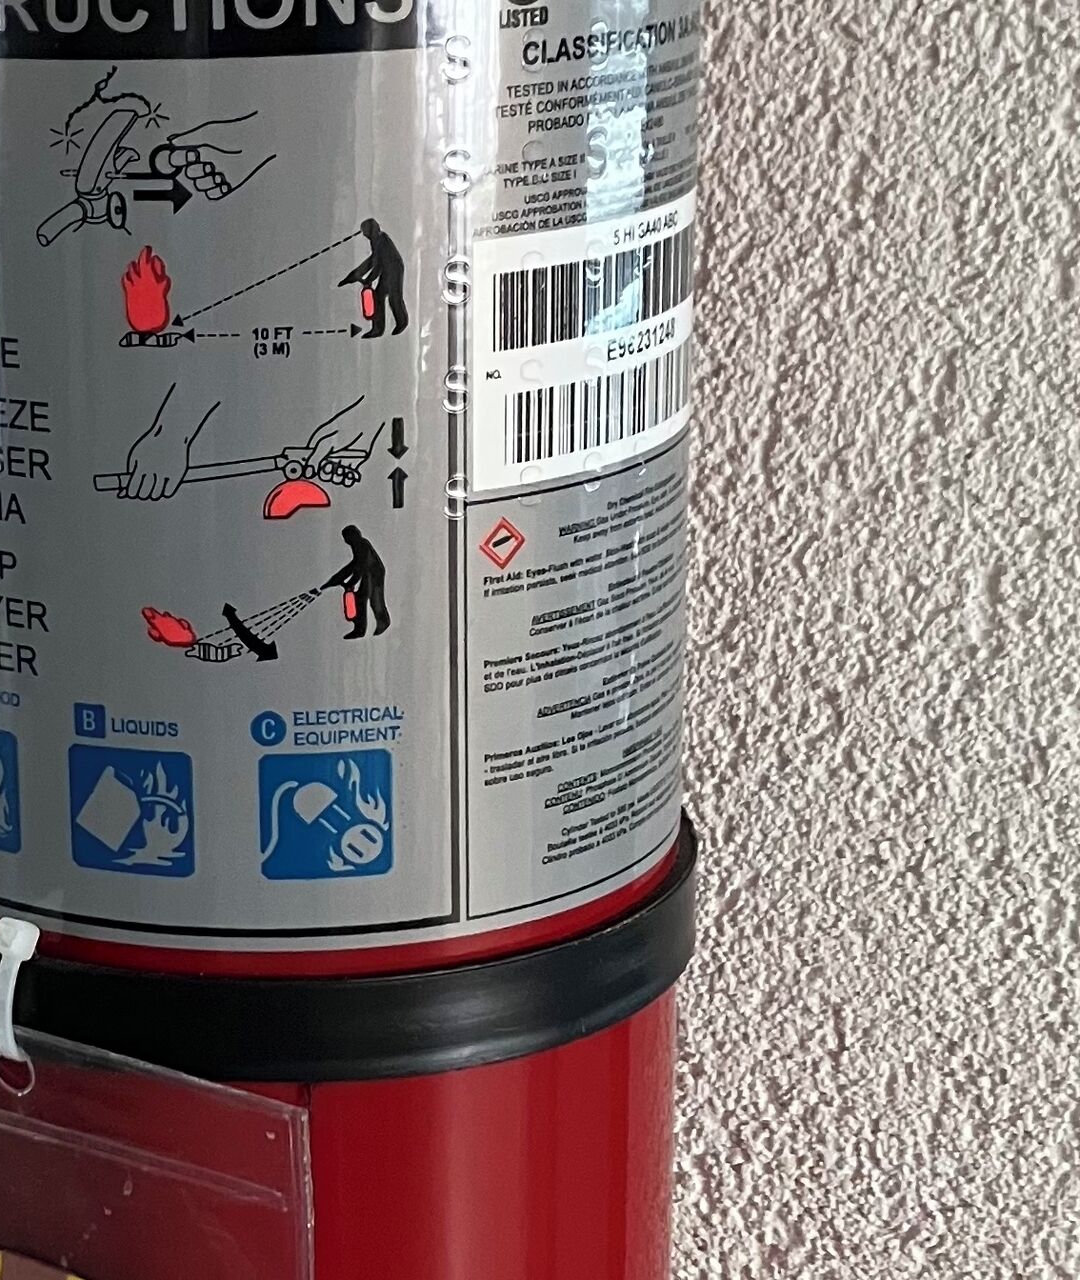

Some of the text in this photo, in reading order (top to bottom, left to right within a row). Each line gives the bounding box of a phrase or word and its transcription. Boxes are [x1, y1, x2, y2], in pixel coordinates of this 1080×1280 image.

[499, 6, 549, 29] LISTED
[522, 19, 676, 66] CLASSIFICATION
[506, 82, 554, 99] TESTED
[557, 80, 568, 94] IN
[528, 116, 584, 134] PROBADO
[521, 157, 547, 171] TYPE
[549, 158, 557, 169] A
[558, 154, 578, 167] SIZE
[551, 170, 572, 182] SIZE
[521, 200, 582, 218] APPROBATION
[538, 219, 550, 230] DE
[552, 216, 564, 228] LA
[613, 230, 621, 245] 5
[623, 226, 635, 240] HI
[252, 326, 294, 342] 10 FT
[253, 342, 291, 358] (3 M)
[573, 531, 590, 544] Keep
[483, 573, 504, 586] First
[491, 584, 524, 596] irritation
[483, 671, 492, 681] et
[494, 669, 505, 679] de
[505, 678, 524, 691] pour
[525, 674, 542, 687] plus
[82, 710, 96, 731] B
[292, 705, 403, 726] ELECTRICAL
[110, 717, 179, 738] LIQUIDS
[261, 720, 276, 739] C
[292, 725, 400, 747] EQUIPMENT
[483, 748, 523, 763] Primeros
